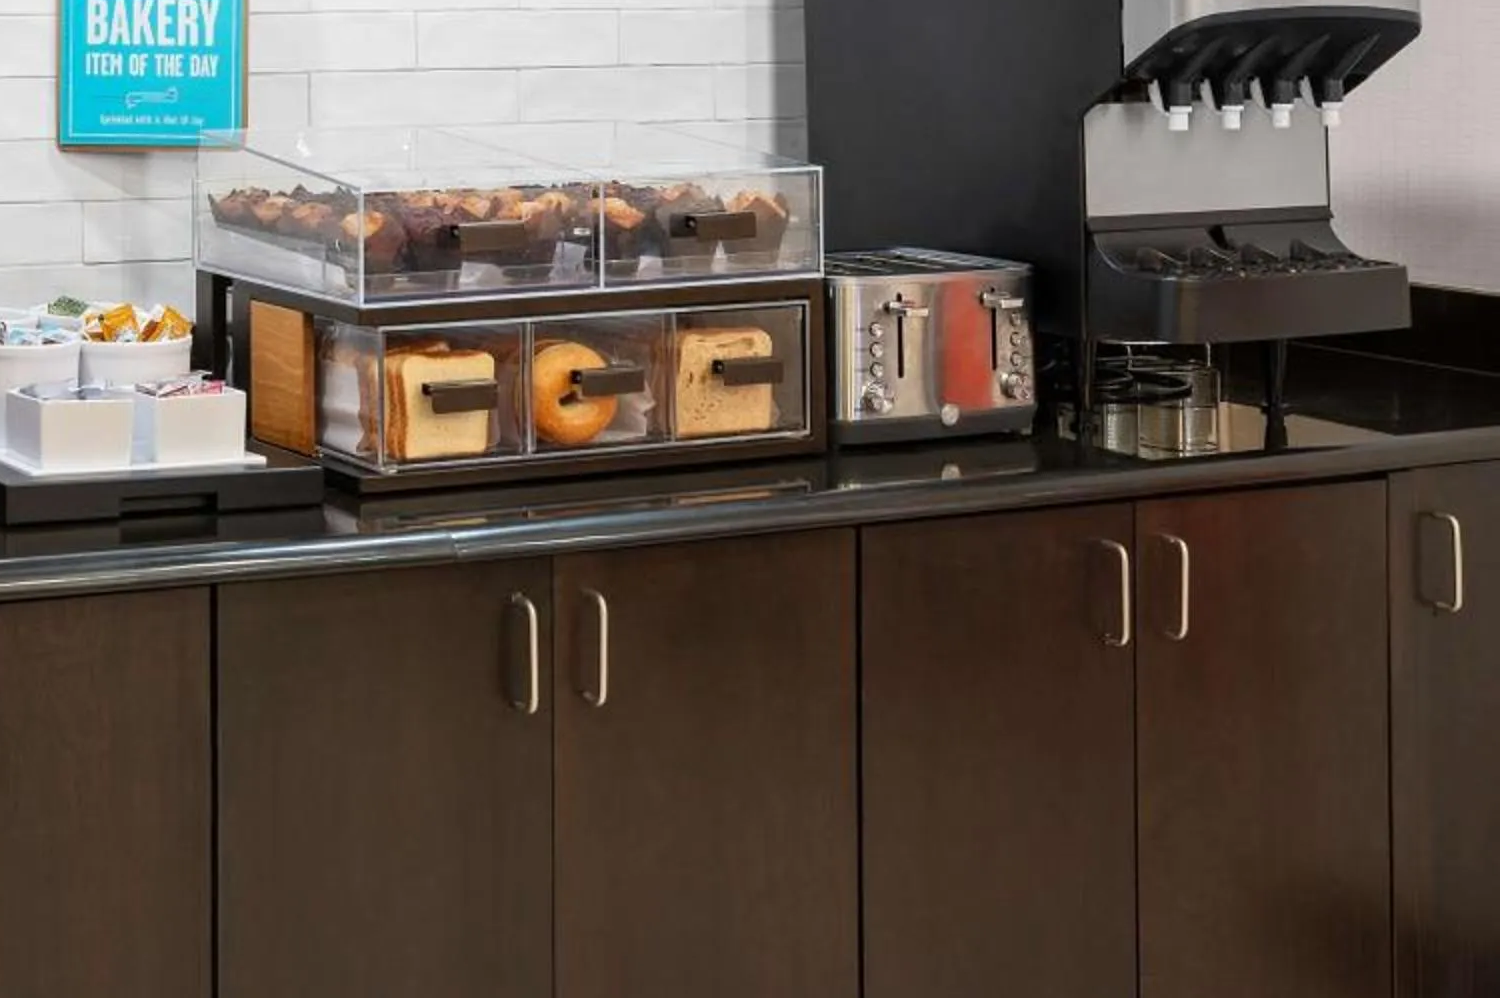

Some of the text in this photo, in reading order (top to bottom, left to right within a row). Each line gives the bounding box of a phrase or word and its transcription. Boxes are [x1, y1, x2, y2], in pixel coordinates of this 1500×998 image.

[86, 52, 219, 78] ITEM OF THE DAY
